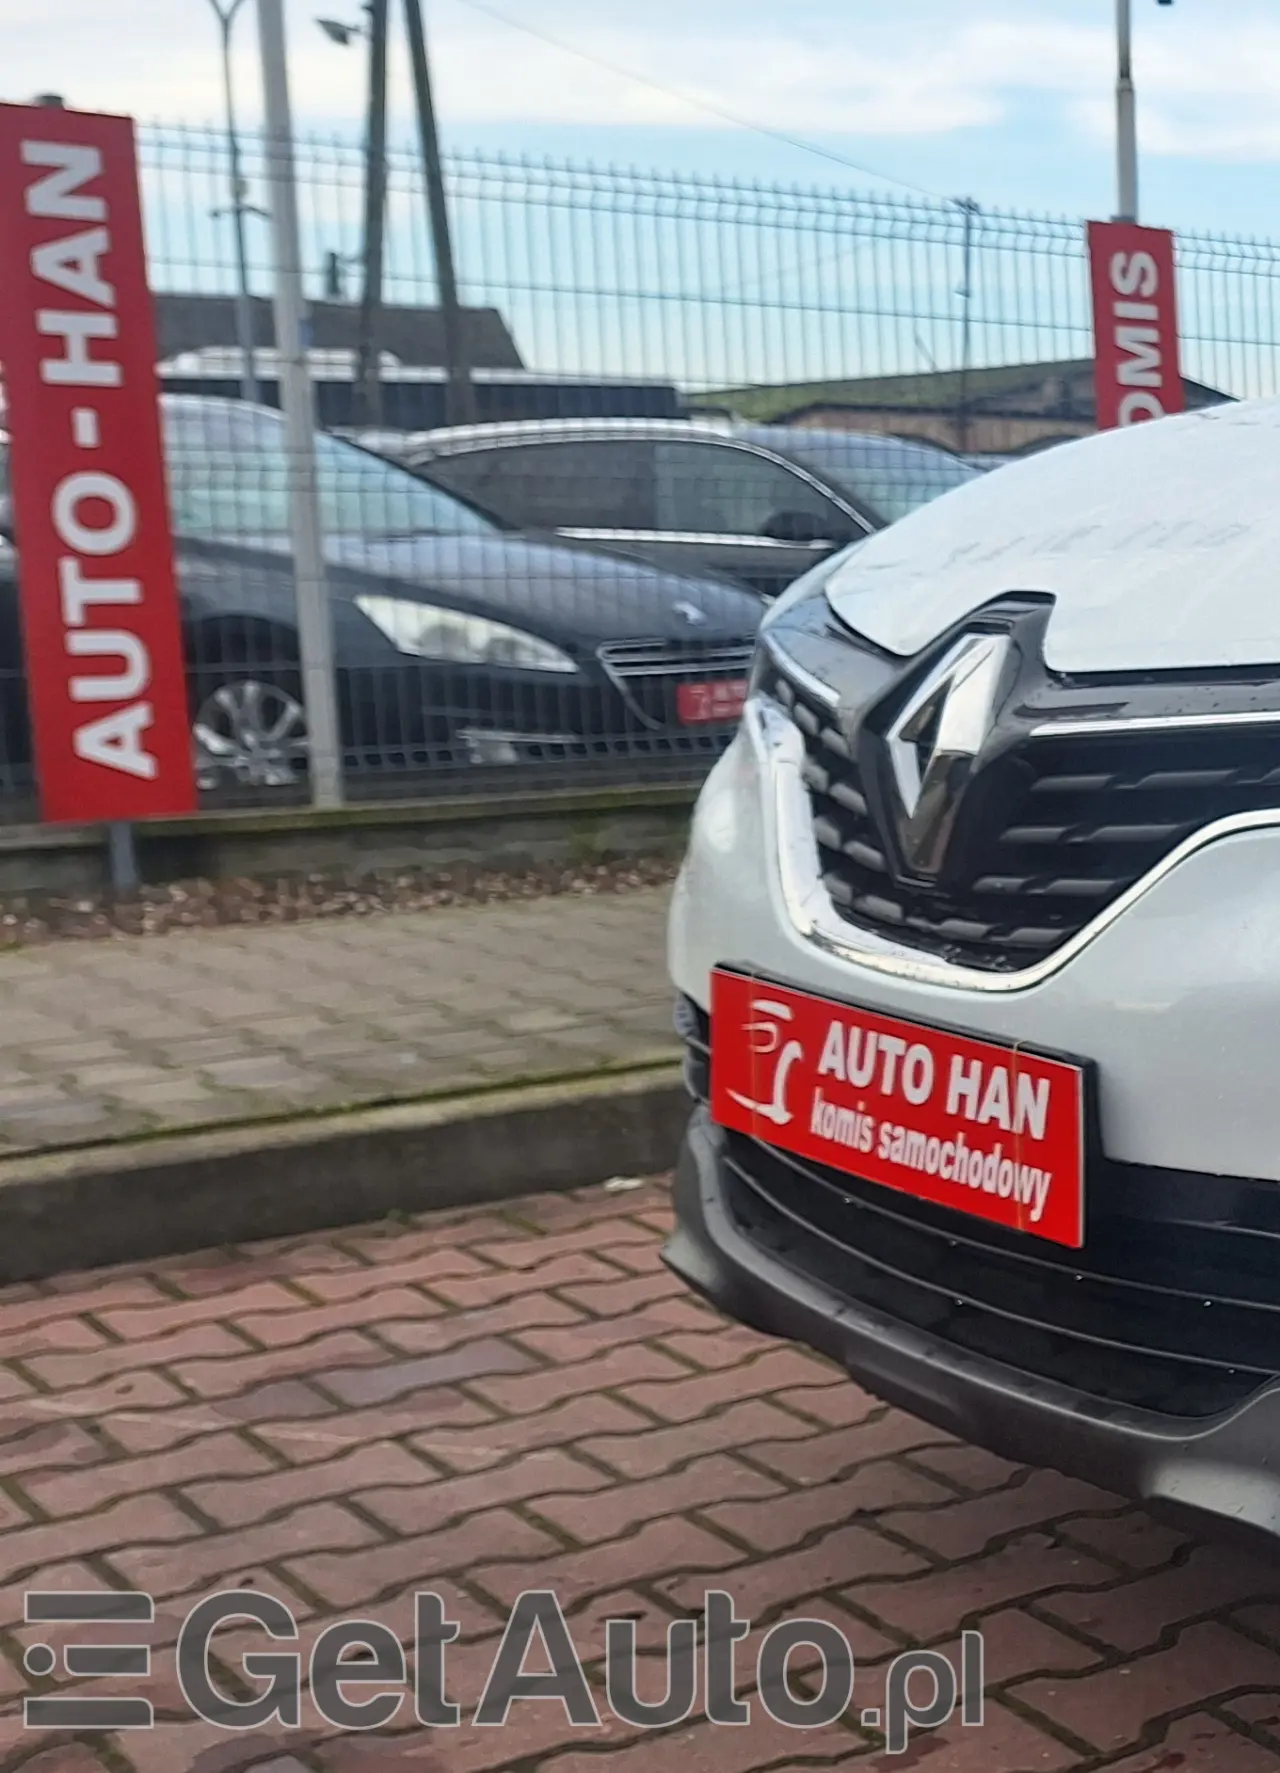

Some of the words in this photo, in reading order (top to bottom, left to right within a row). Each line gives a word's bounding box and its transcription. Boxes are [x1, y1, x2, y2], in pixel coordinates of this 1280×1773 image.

[20, 140, 123, 385] HAN
[1109, 251, 1165, 428] OMIS
[52, 471, 160, 780] AUTO
[810, 1086, 875, 1154] komis
[878, 1120, 1053, 1222] samochodowy
[818, 1021, 934, 1105] AUTO
[946, 1054, 1050, 1140] HAN
